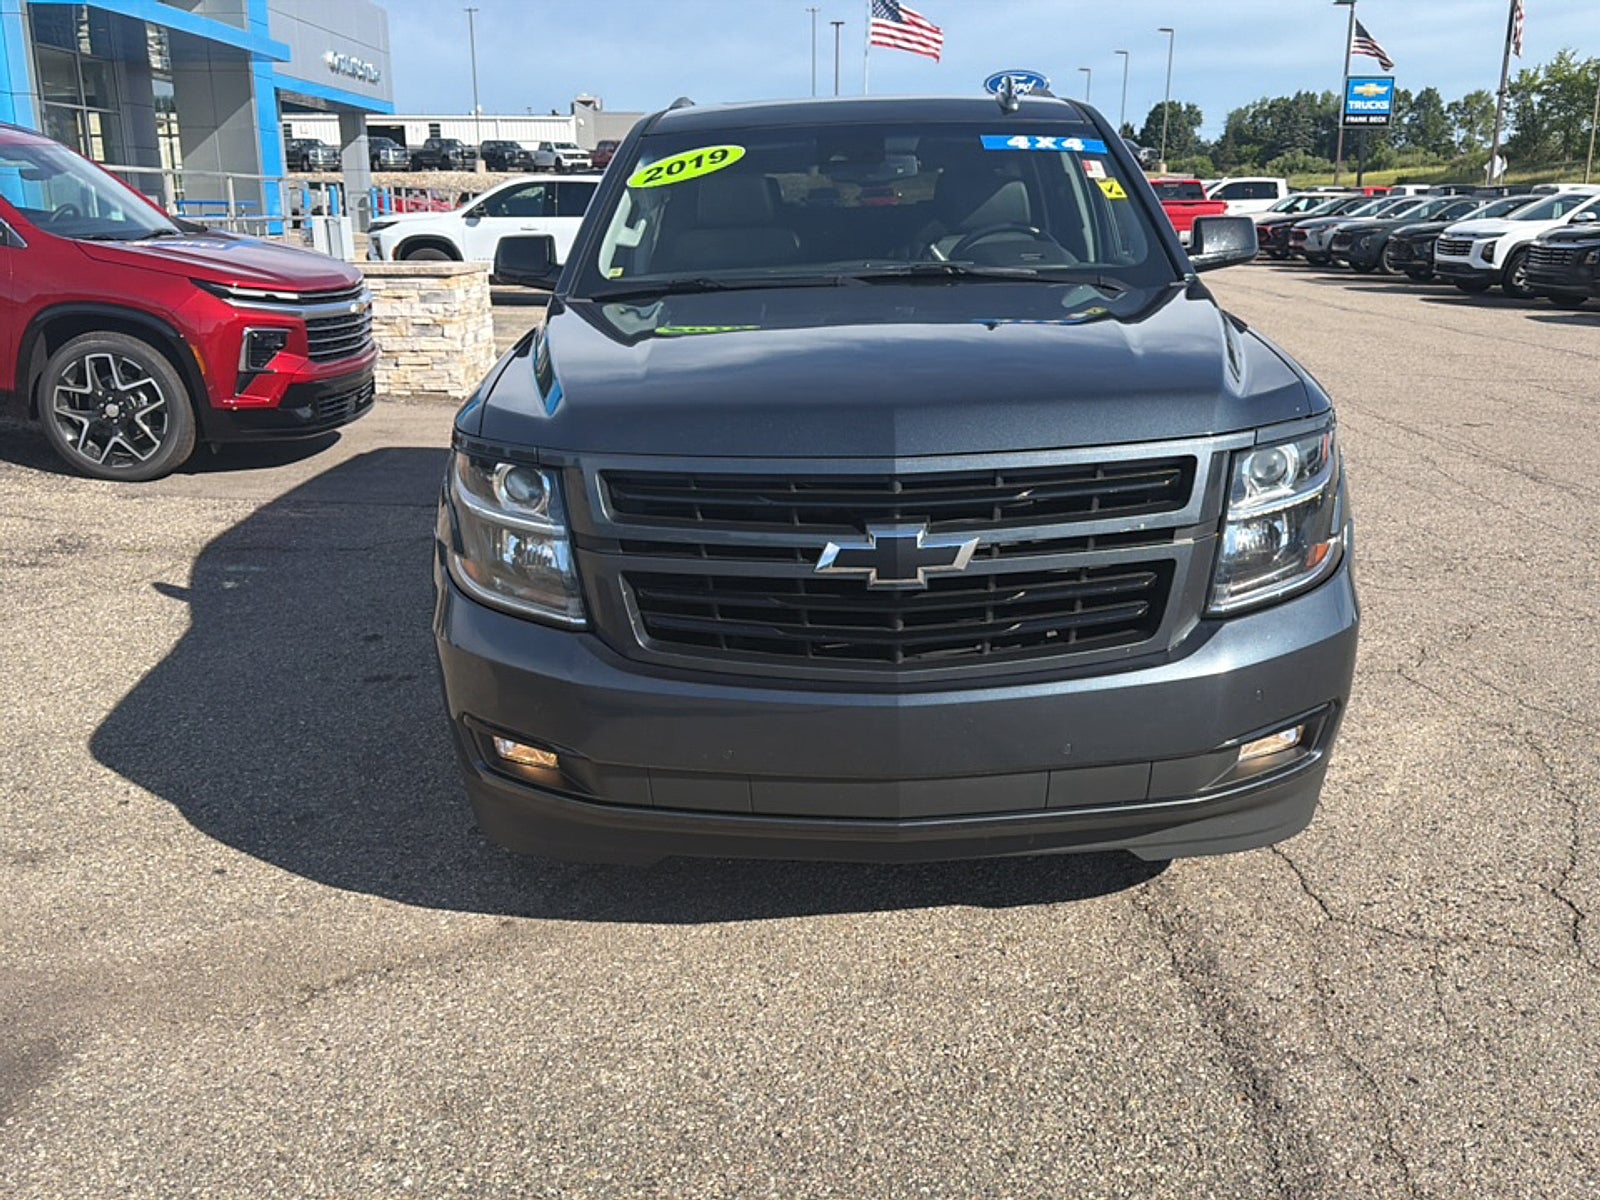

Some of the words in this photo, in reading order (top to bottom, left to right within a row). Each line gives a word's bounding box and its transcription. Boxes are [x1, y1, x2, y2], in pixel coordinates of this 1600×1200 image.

[997, 76, 1036, 95] Ford
[1348, 100, 1390, 109] TRUCKS
[643, 149, 728, 184] 2019
